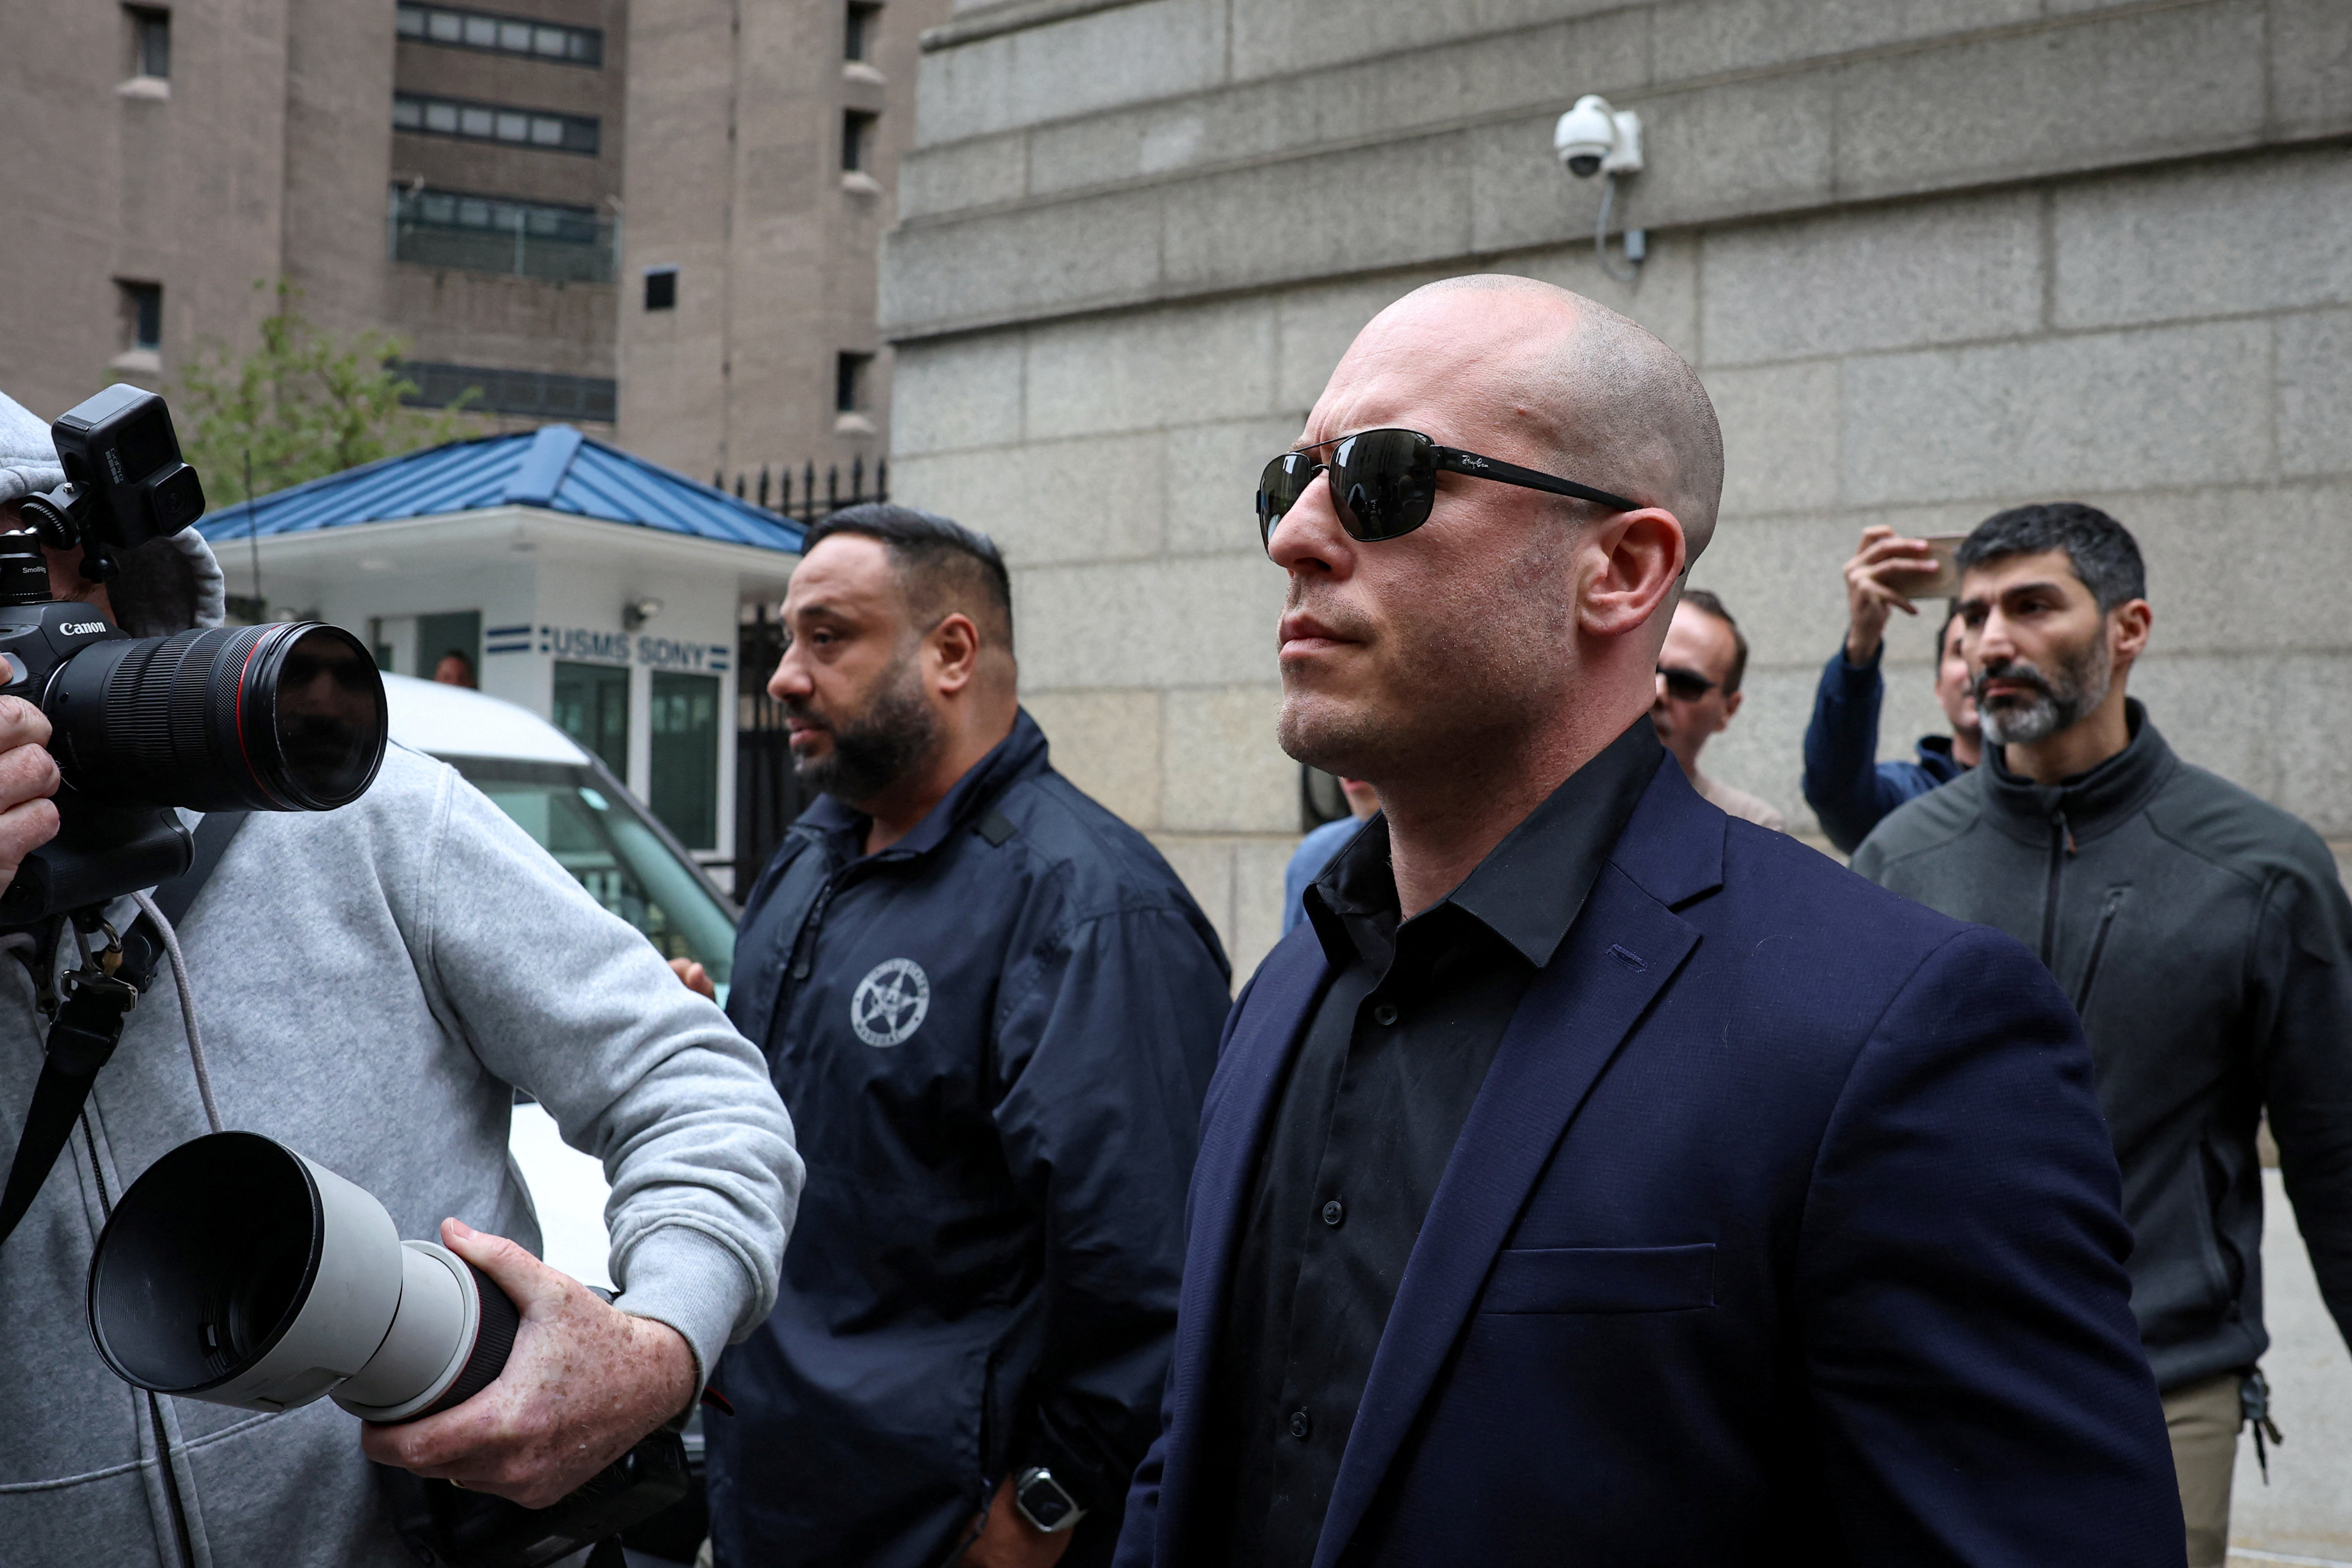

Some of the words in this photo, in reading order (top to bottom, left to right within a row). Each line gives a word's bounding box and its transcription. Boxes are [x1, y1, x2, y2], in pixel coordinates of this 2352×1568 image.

[110, 448, 124, 481] GoPro
[59, 621, 106, 636] Canon
[552, 626, 630, 660] USMS
[638, 635, 707, 666] SDNY
